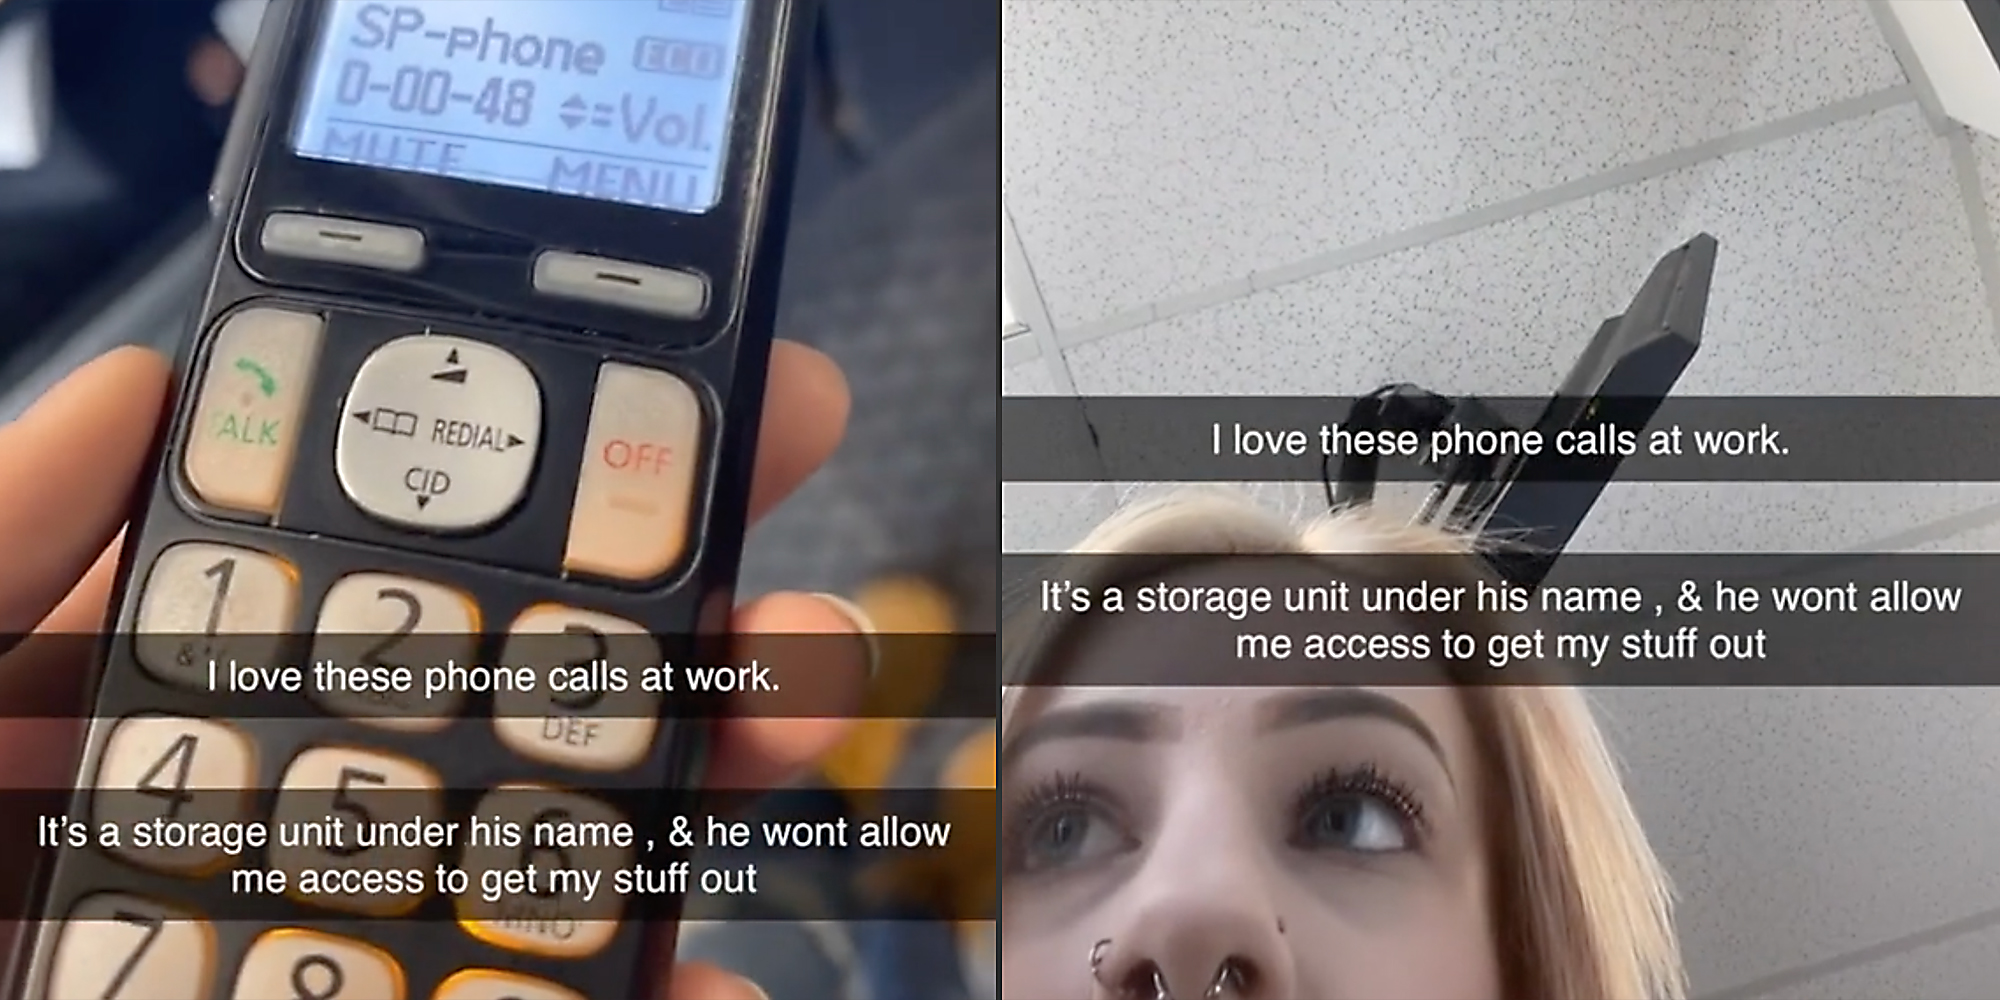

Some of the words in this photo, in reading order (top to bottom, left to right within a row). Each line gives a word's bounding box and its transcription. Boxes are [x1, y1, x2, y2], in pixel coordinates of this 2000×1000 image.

[349, 3, 606, 76] SP-phone
[549, 155, 699, 204] MENU
[432, 421, 505, 453] REDIAL
[602, 439, 674, 476] OFF
[404, 466, 451, 497] CID
[203, 557, 237, 641] 1
[360, 586, 424, 677] 2
[548, 622, 609, 710] 3
[542, 712, 600, 747] DEF
[134, 731, 202, 820] 4
[322, 765, 388, 859] 5
[102, 910, 165, 1000] 7
